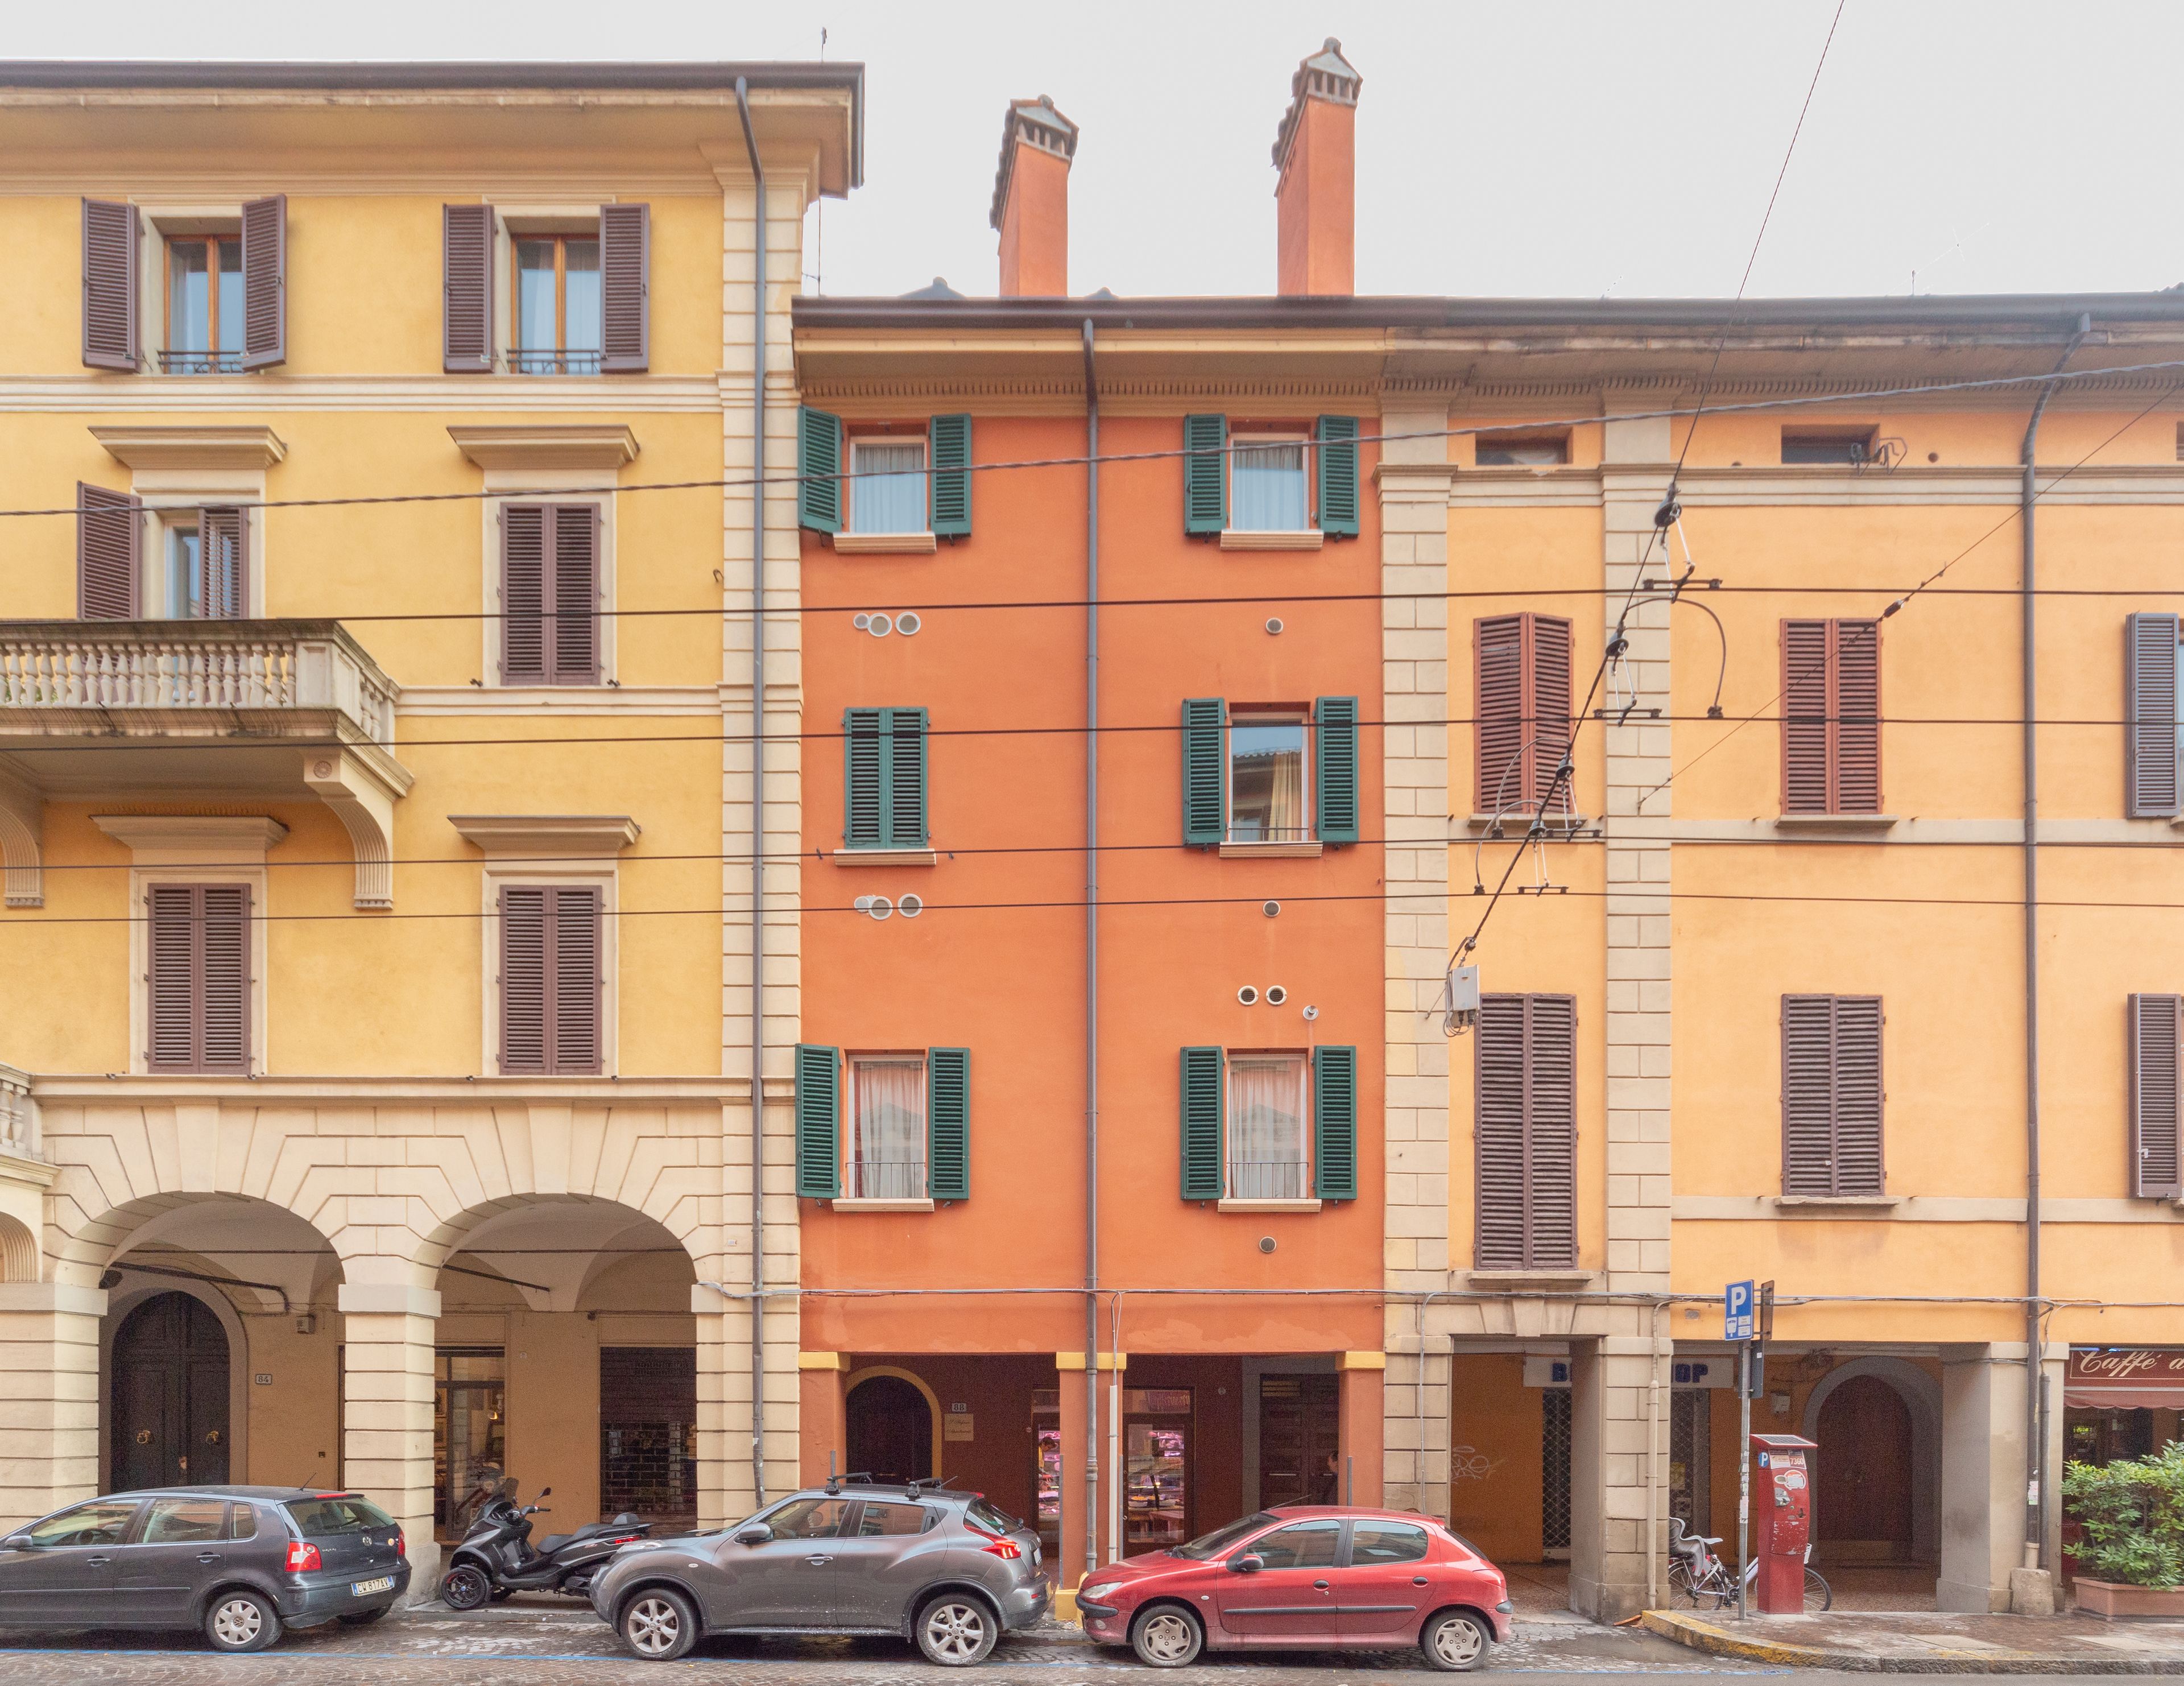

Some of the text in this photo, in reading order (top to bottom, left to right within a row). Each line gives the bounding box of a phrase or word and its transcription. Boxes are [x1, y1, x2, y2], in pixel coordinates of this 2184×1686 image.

[1731, 1286, 1747, 1315] P
[1671, 1363, 1709, 1383] OP
[1761, 1452, 1769, 1466] P
